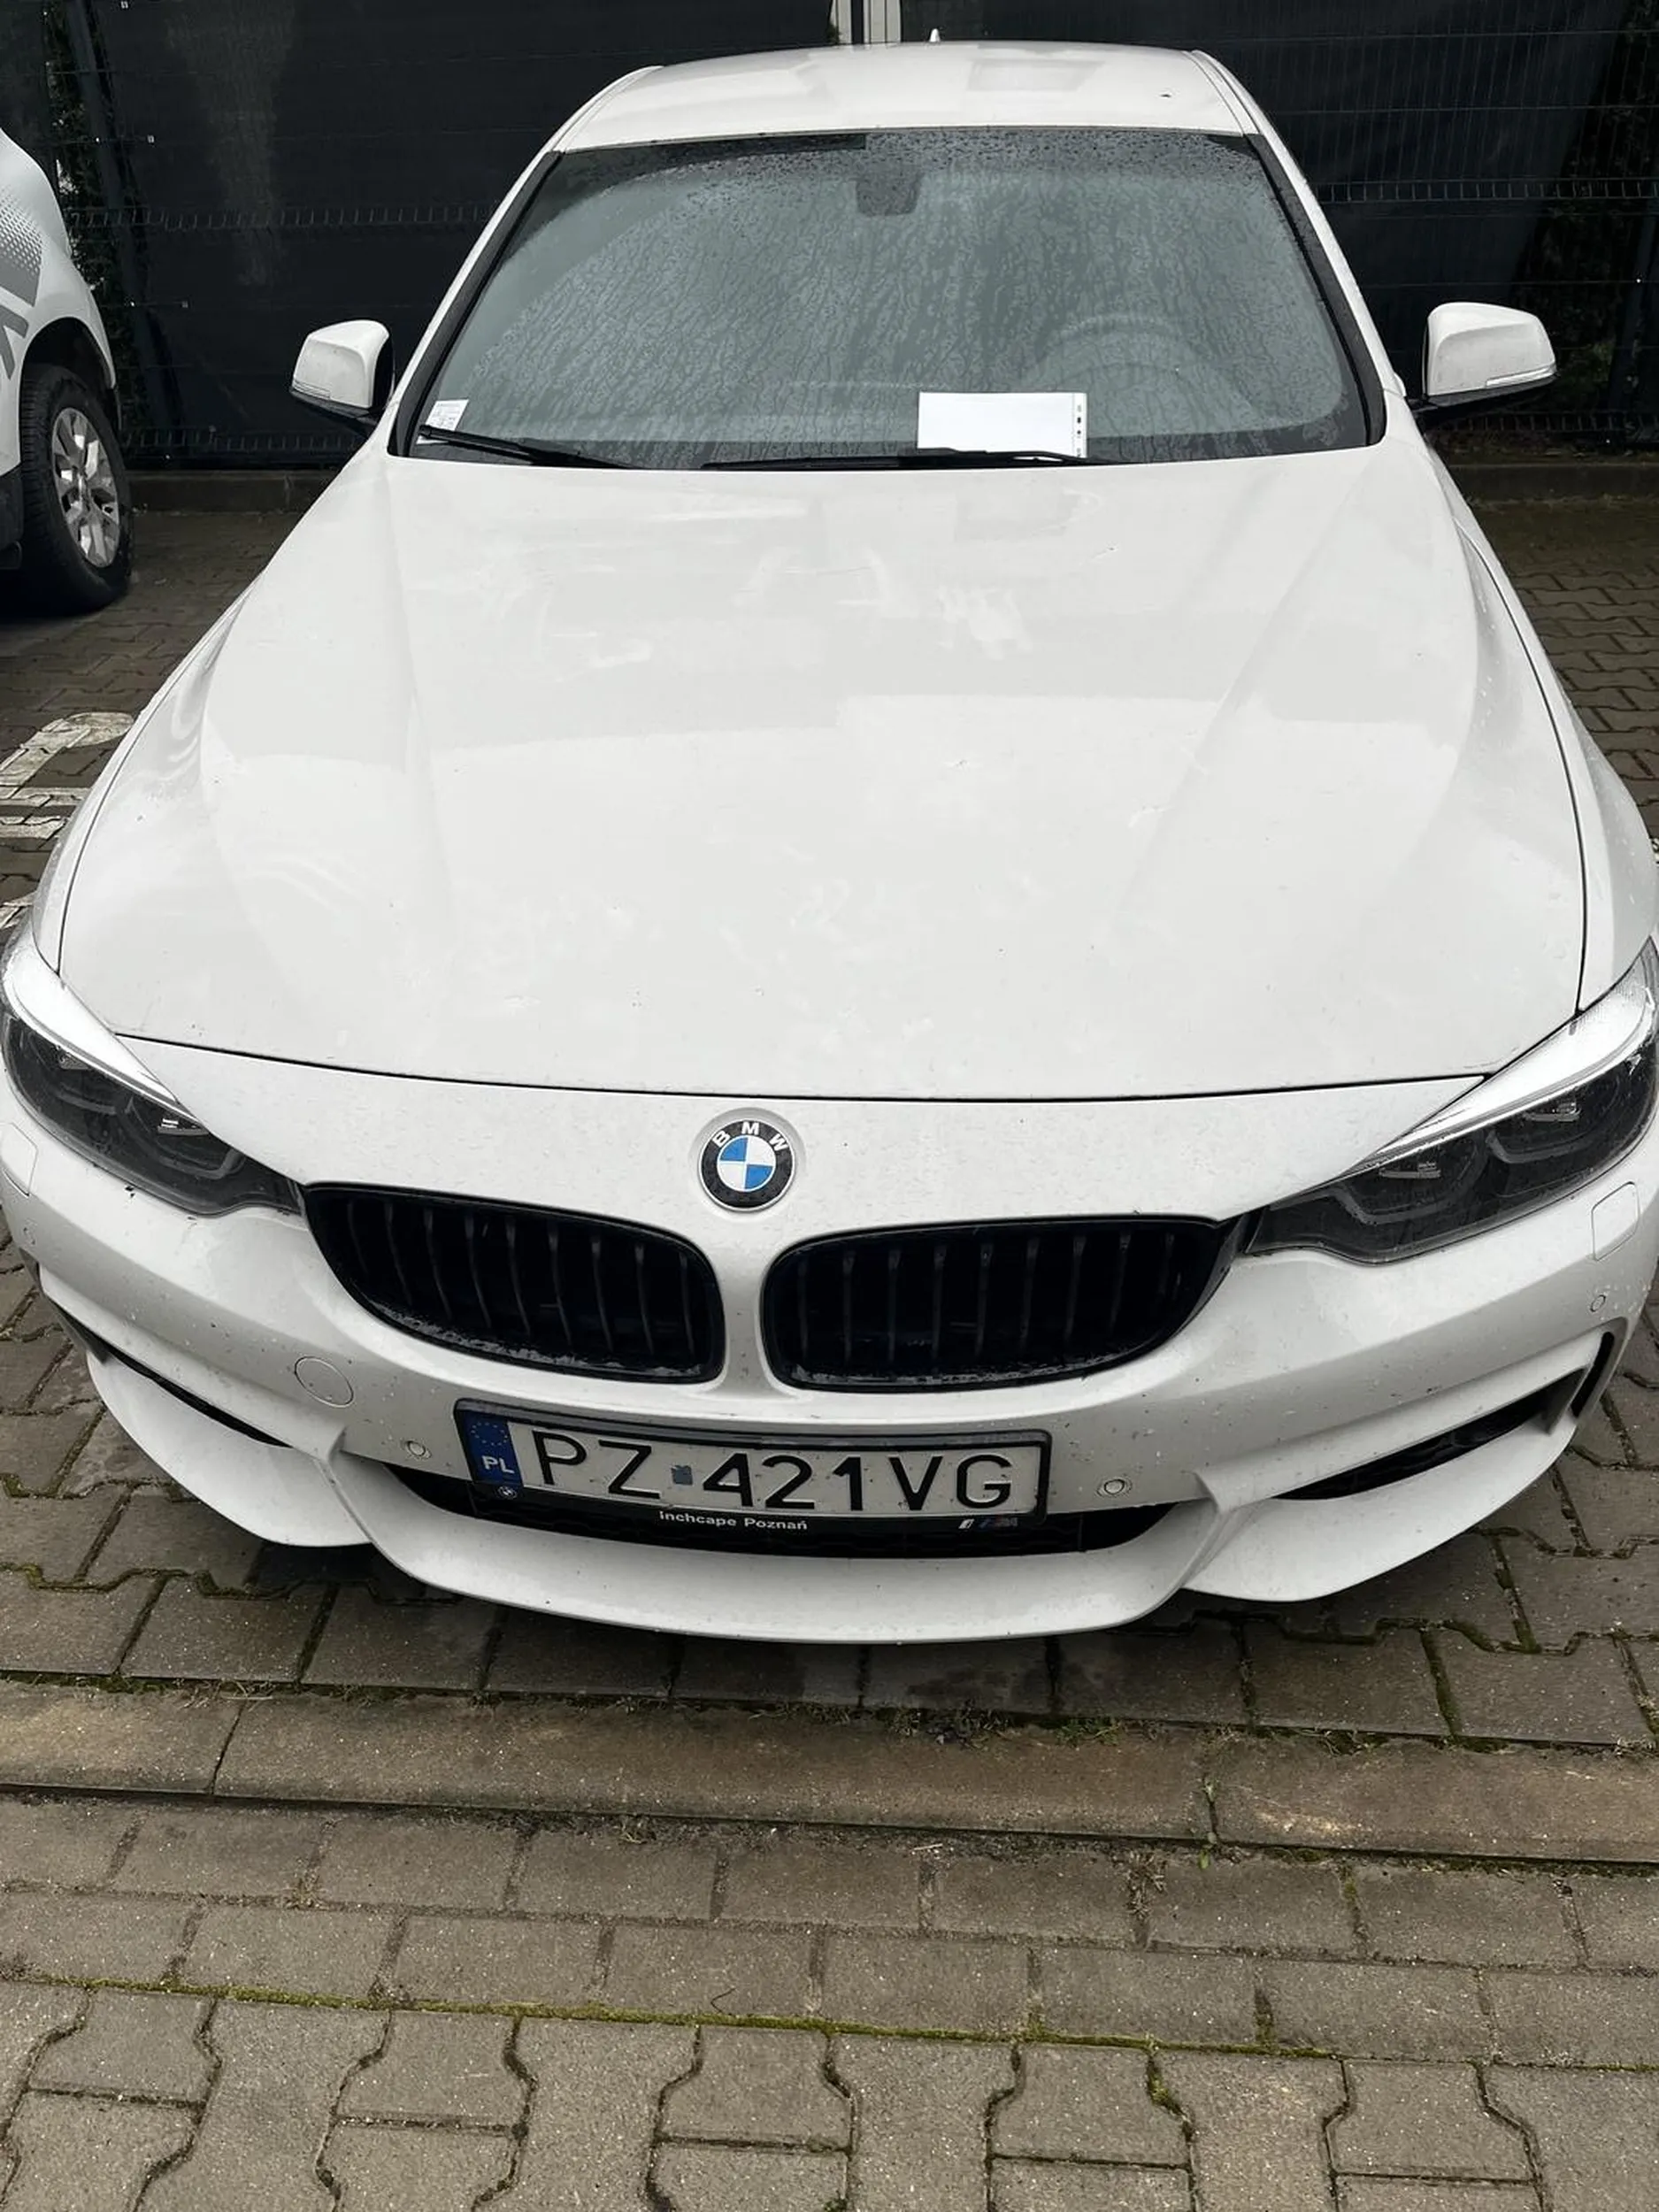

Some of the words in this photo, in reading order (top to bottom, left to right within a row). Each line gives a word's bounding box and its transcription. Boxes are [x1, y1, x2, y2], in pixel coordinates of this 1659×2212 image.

[711, 1121, 789, 1151] BMW
[481, 1455, 515, 1474] PL
[532, 1430, 660, 1500] PZ
[703, 1452, 1012, 1511] 421VG
[744, 1517, 808, 1530] Poznań
